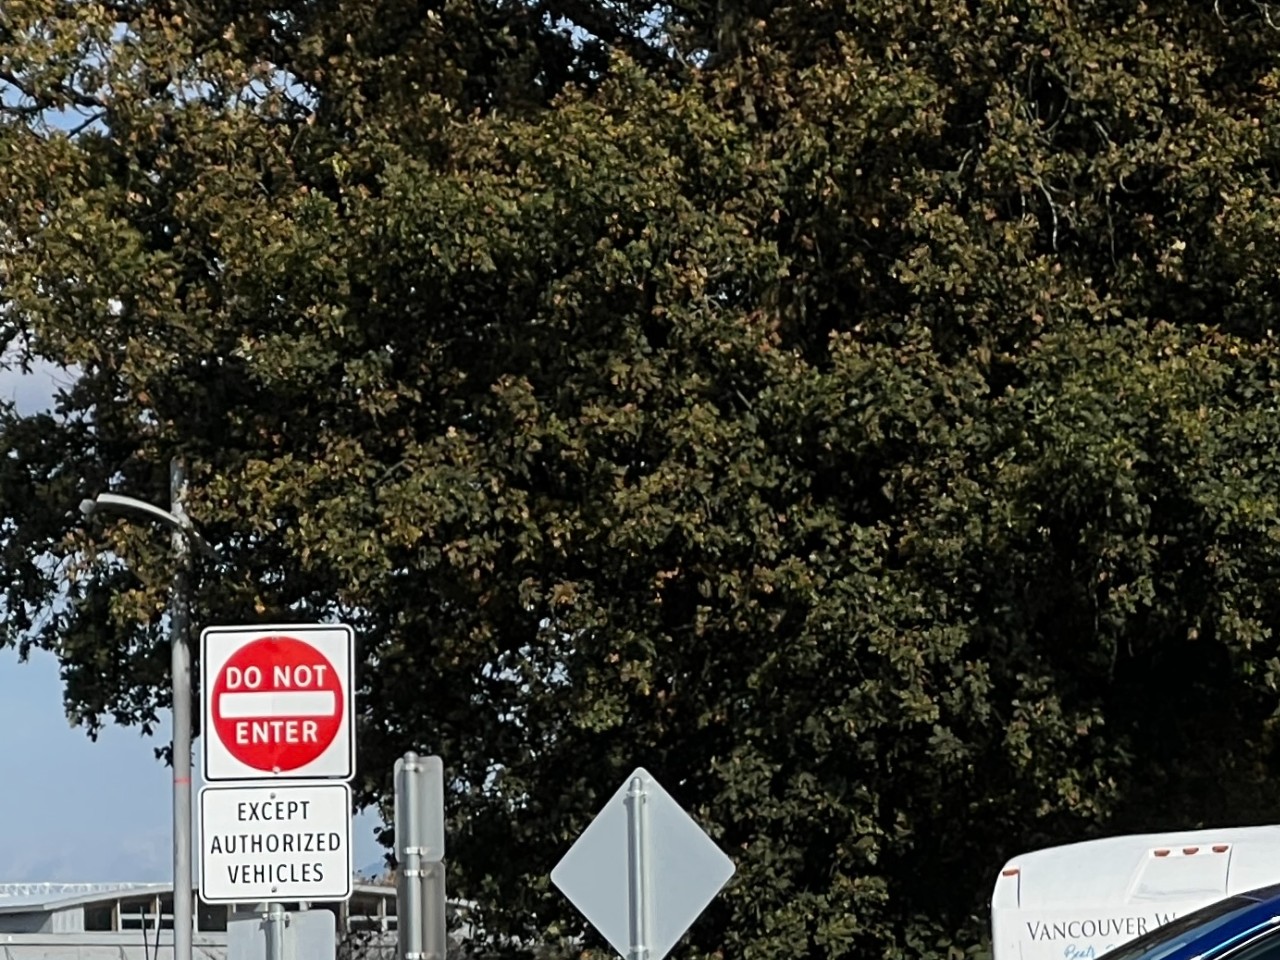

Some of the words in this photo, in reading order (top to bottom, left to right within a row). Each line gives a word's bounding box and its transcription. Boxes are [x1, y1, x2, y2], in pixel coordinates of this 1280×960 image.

[225, 665, 262, 689] DO
[273, 664, 327, 688] NOT
[236, 720, 318, 744] ENTER
[237, 801, 310, 821] EXCEPT
[210, 832, 341, 854] AUTHORIZED
[227, 863, 324, 884] VEHICLES
[1027, 916, 1148, 941] VANCOUVER
